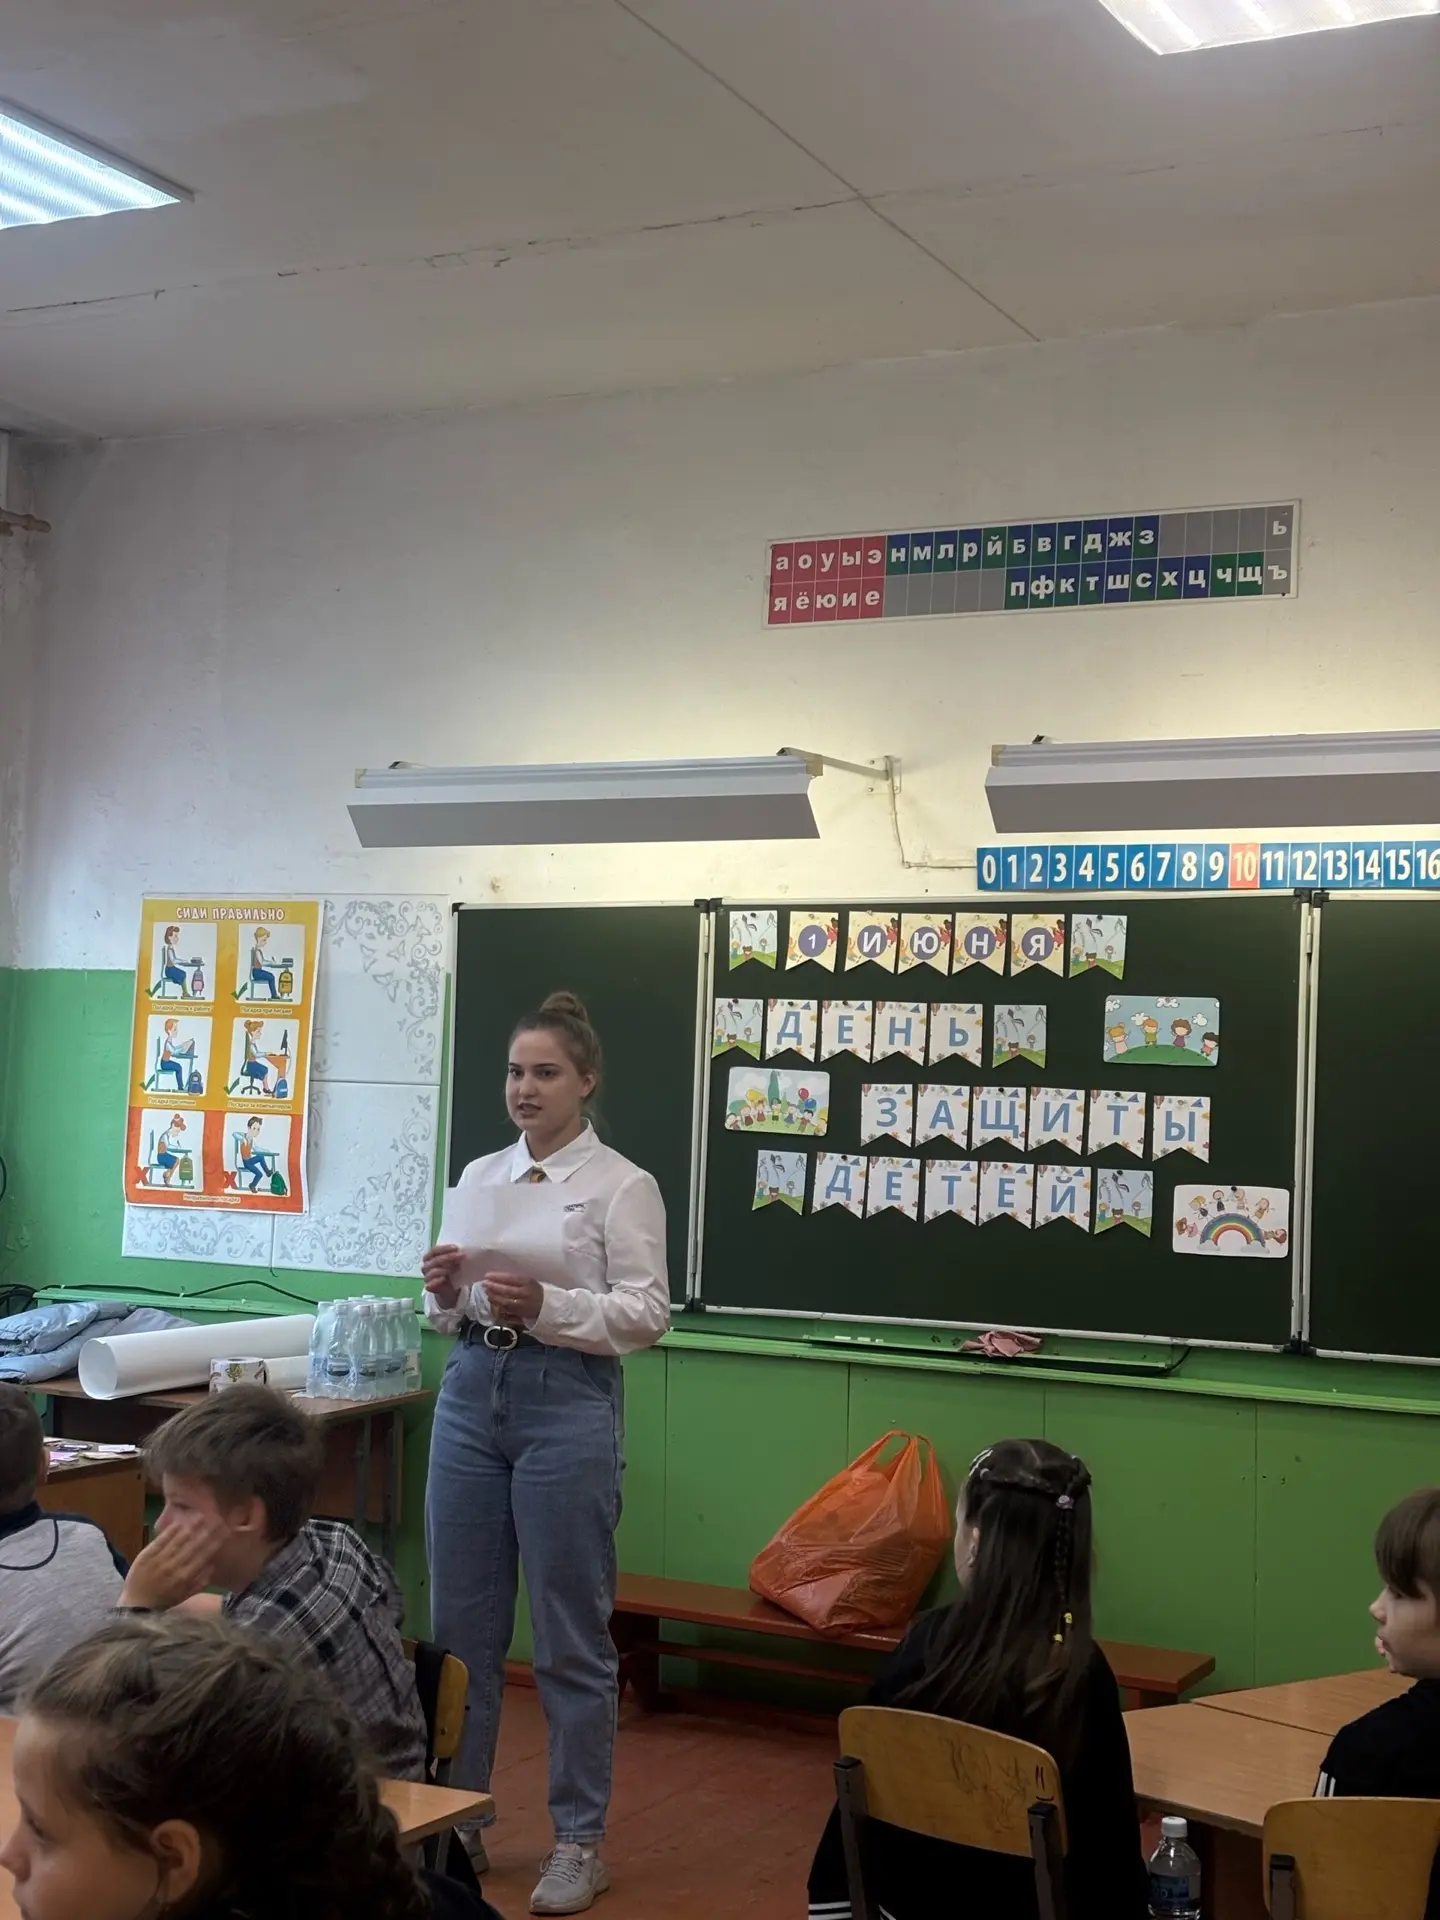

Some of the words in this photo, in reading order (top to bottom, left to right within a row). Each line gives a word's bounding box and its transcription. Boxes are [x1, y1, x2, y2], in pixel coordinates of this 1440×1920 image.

[775, 556, 788, 570] а
[799, 555, 812, 569] о
[821, 553, 834, 572] у
[842, 551, 861, 565] ы
[868, 550, 881, 564] э
[892, 547, 905, 562] н
[914, 546, 931, 560] м
[937, 544, 953, 558] л
[963, 543, 977, 562] р
[988, 535, 1002, 555] й
[1038, 537, 1051, 552] в
[1064, 535, 1075, 550] г
[1084, 534, 1102, 554] д
[1108, 532, 1131, 547] ж
[1139, 530, 1154, 544] з
[1273, 521, 1287, 535] ь
[774, 597, 786, 611] я
[796, 592, 809, 609] ё
[816, 594, 836, 608] ю
[842, 593, 856, 606] и
[866, 590, 879, 605] е
[1011, 581, 1024, 596] п
[1031, 575, 1055, 599] ф
[1060, 578, 1074, 592] к
[1086, 576, 1099, 590] т
[1108, 574, 1129, 589] ш
[1136, 573, 1152, 587] с
[1162, 572, 1178, 586] х
[1189, 570, 1205, 588] ц
[1217, 568, 1232, 582] ч
[1238, 565, 1262, 584] щ
[1268, 565, 1287, 580] ъ
[984, 855, 996, 884] 0
[1007, 855, 1017, 883] 1
[1029, 854, 1042, 882] 2
[1053, 853, 1067, 882] 3
[1079, 853, 1094, 881] 4
[1105, 853, 1119, 882] 5
[1131, 852, 1145, 881] 6
[1157, 852, 1171, 881] 7
[1181, 851, 1197, 881] 8
[1209, 851, 1224, 881] 9
[1232, 851, 1257, 881] 10
[1262, 851, 1284, 881] 11
[1292, 850, 1317, 880] 12
[1323, 850, 1348, 880] 13
[1354, 850, 1381, 880] 14
[1385, 849, 1411, 879] 15
[176, 907, 207, 919] СИДИ
[212, 908, 285, 920] ПРАВИЛЬНО
[808, 934, 816, 949] 1
[863, 932, 1045, 956] ИЮНЯ
[777, 1011, 969, 1047] ДЕНЬ
[876, 1097, 1195, 1142] ЗАЩИТЫ
[825, 1165, 1076, 1213] ДЕТЕЙ
